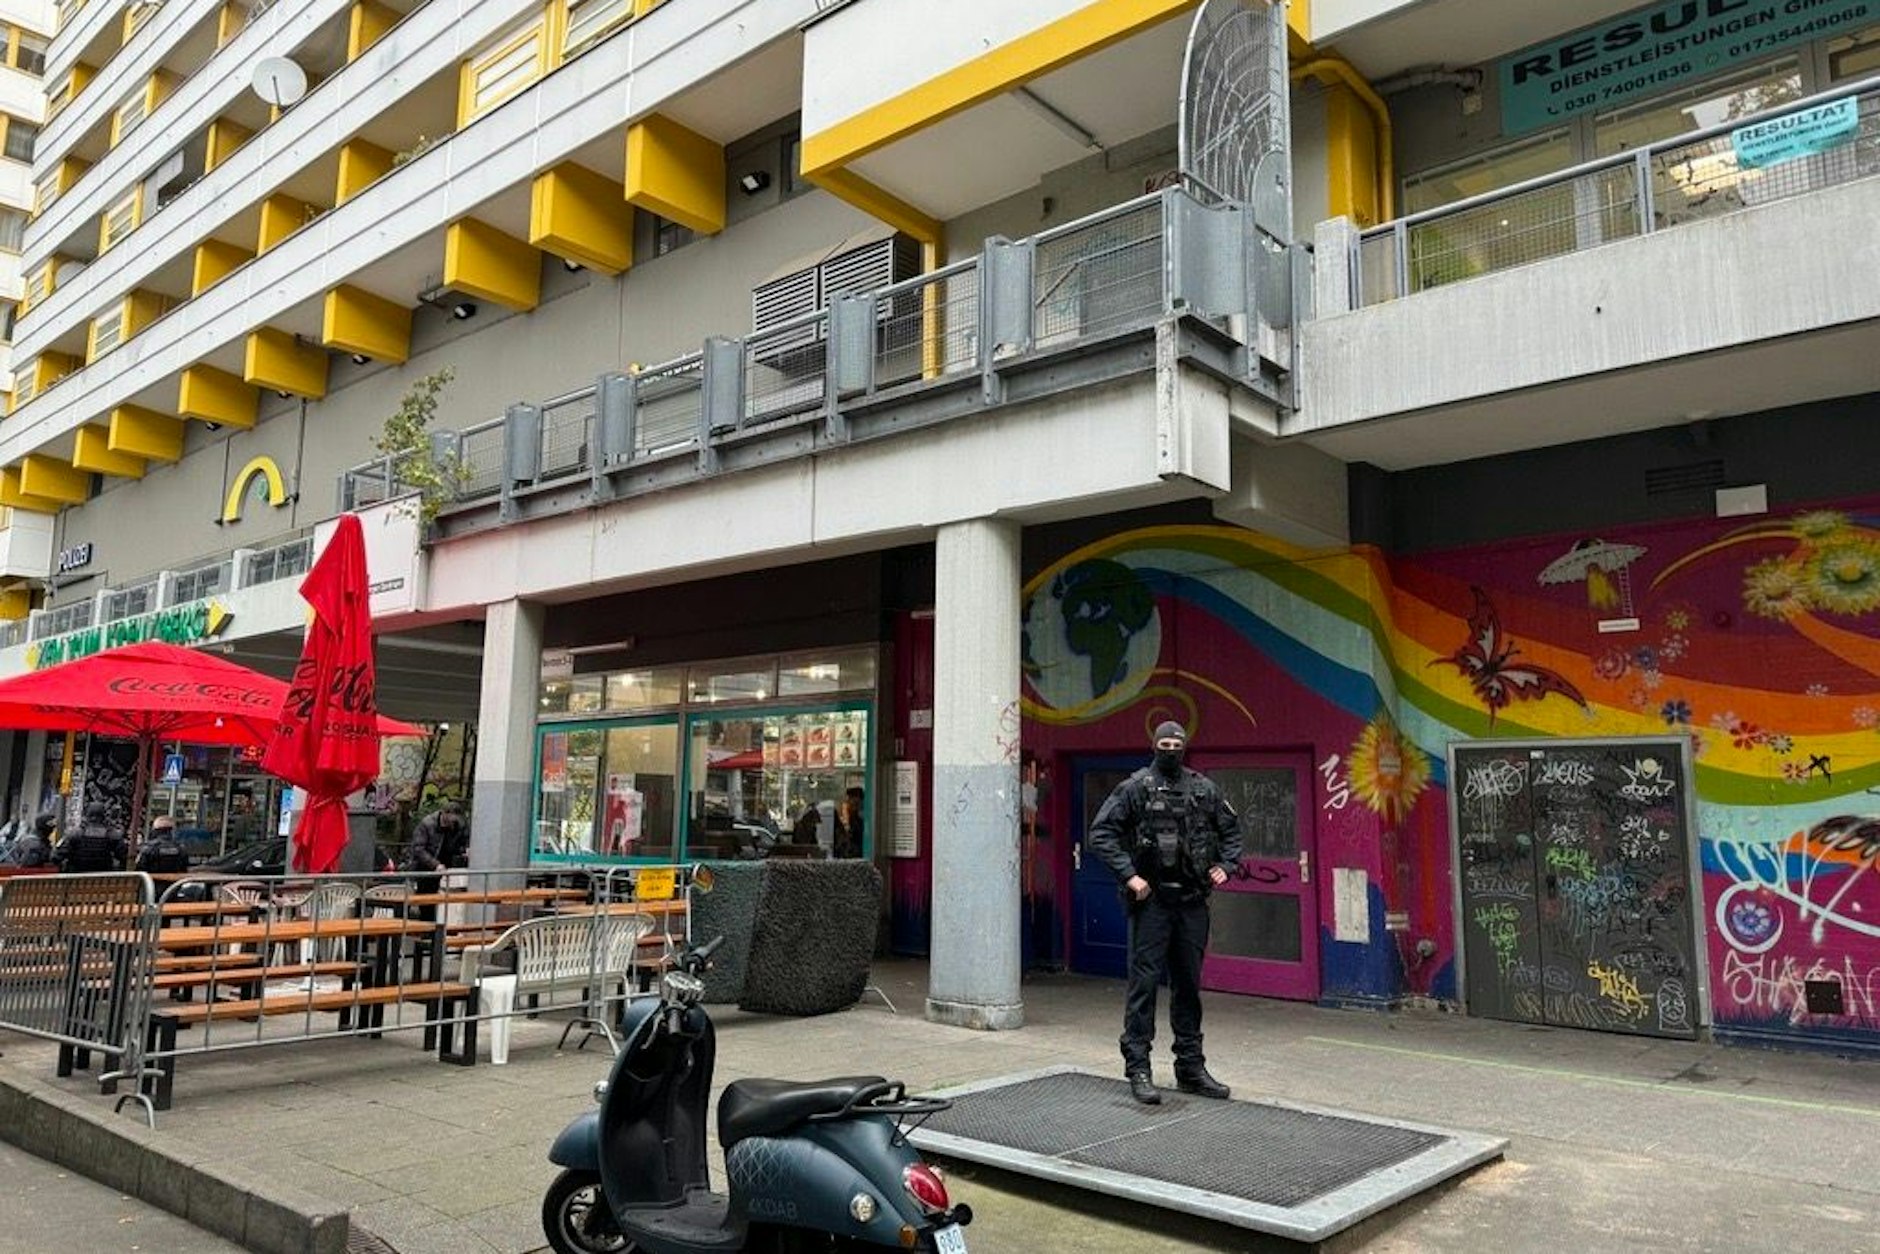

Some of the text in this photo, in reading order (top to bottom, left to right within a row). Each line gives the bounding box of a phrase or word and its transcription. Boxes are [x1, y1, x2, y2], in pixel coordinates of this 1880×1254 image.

[1565, 94, 1596, 111] 030
[1602, 62, 1692, 98] 74001836
[1740, 102, 1849, 142] RESULTAT
